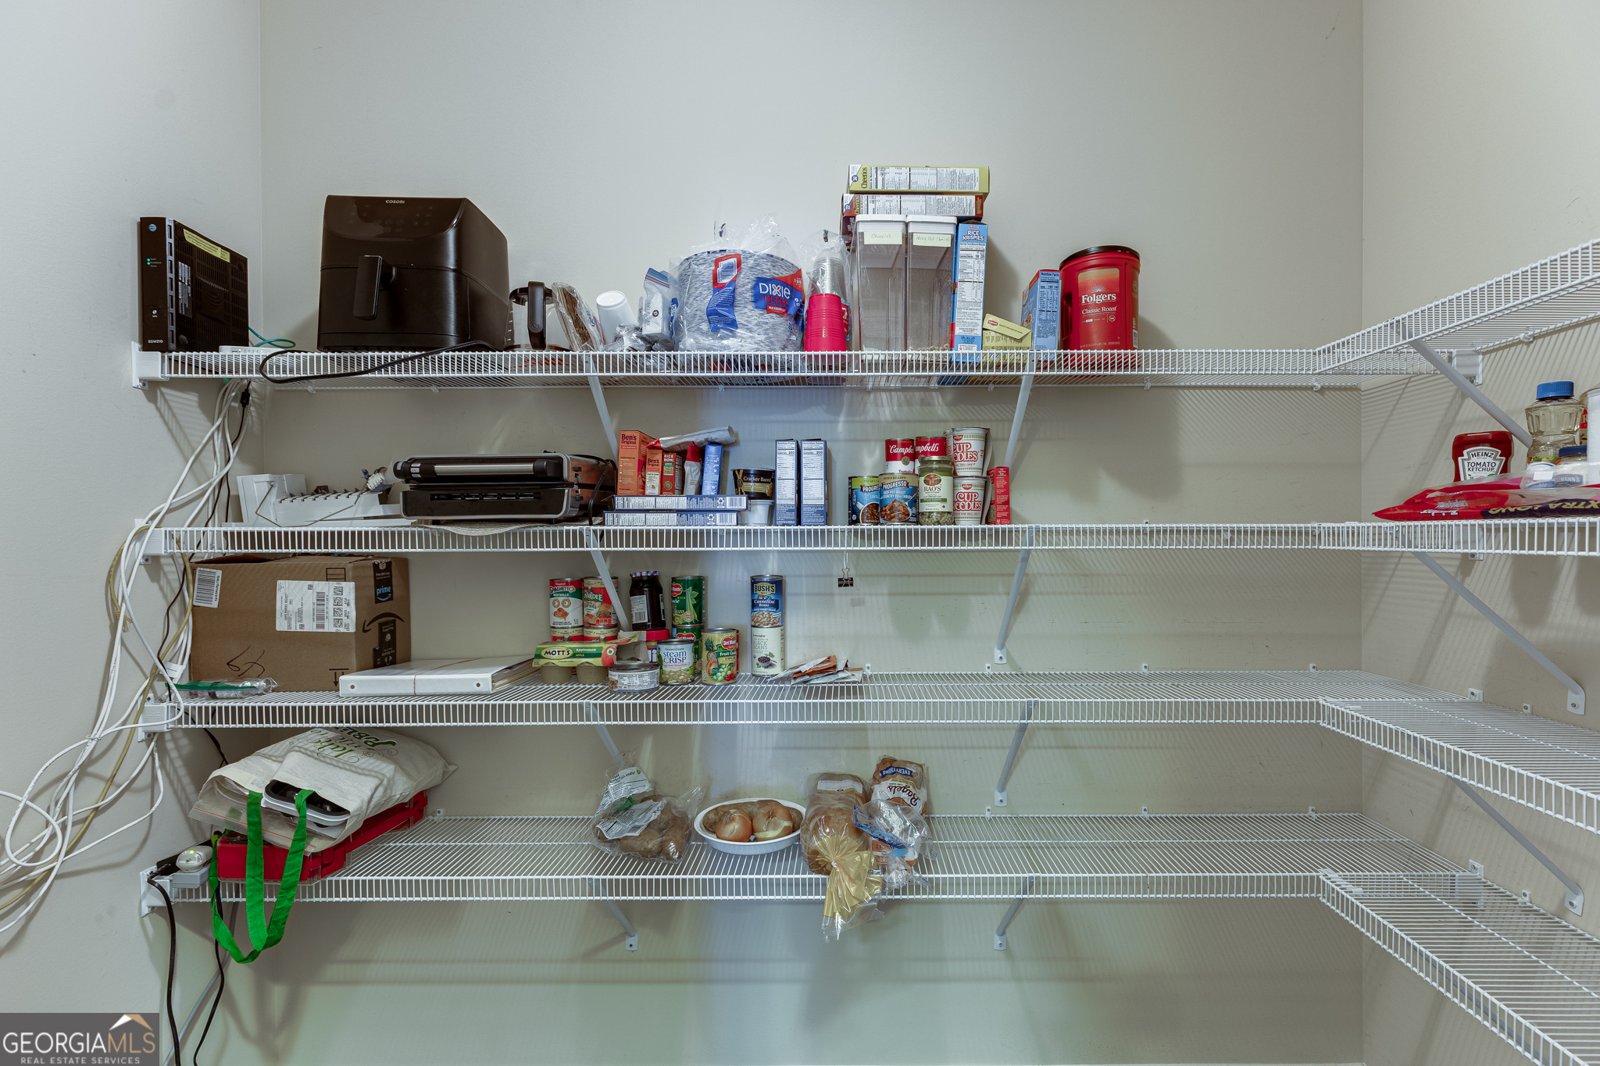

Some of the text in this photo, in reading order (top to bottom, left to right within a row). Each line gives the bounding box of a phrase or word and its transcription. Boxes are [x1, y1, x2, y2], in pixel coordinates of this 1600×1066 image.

[1081, 293, 1117, 304] Folgers
[1081, 307, 1101, 315] Classic
[889, 444, 914, 455] Campb
[915, 443, 940, 454] mpbell's
[953, 442, 972, 452] UP
[953, 451, 979, 462] ODLES
[956, 491, 979, 502] CUP
[1548, 500, 1600, 509] XTRA
[376, 585, 391, 596] prime
[754, 585, 775, 593] BUSH'S
[543, 648, 570, 656] MOTT'S
[663, 656, 687, 664] CRISP
[887, 785, 921, 807] Bagels
